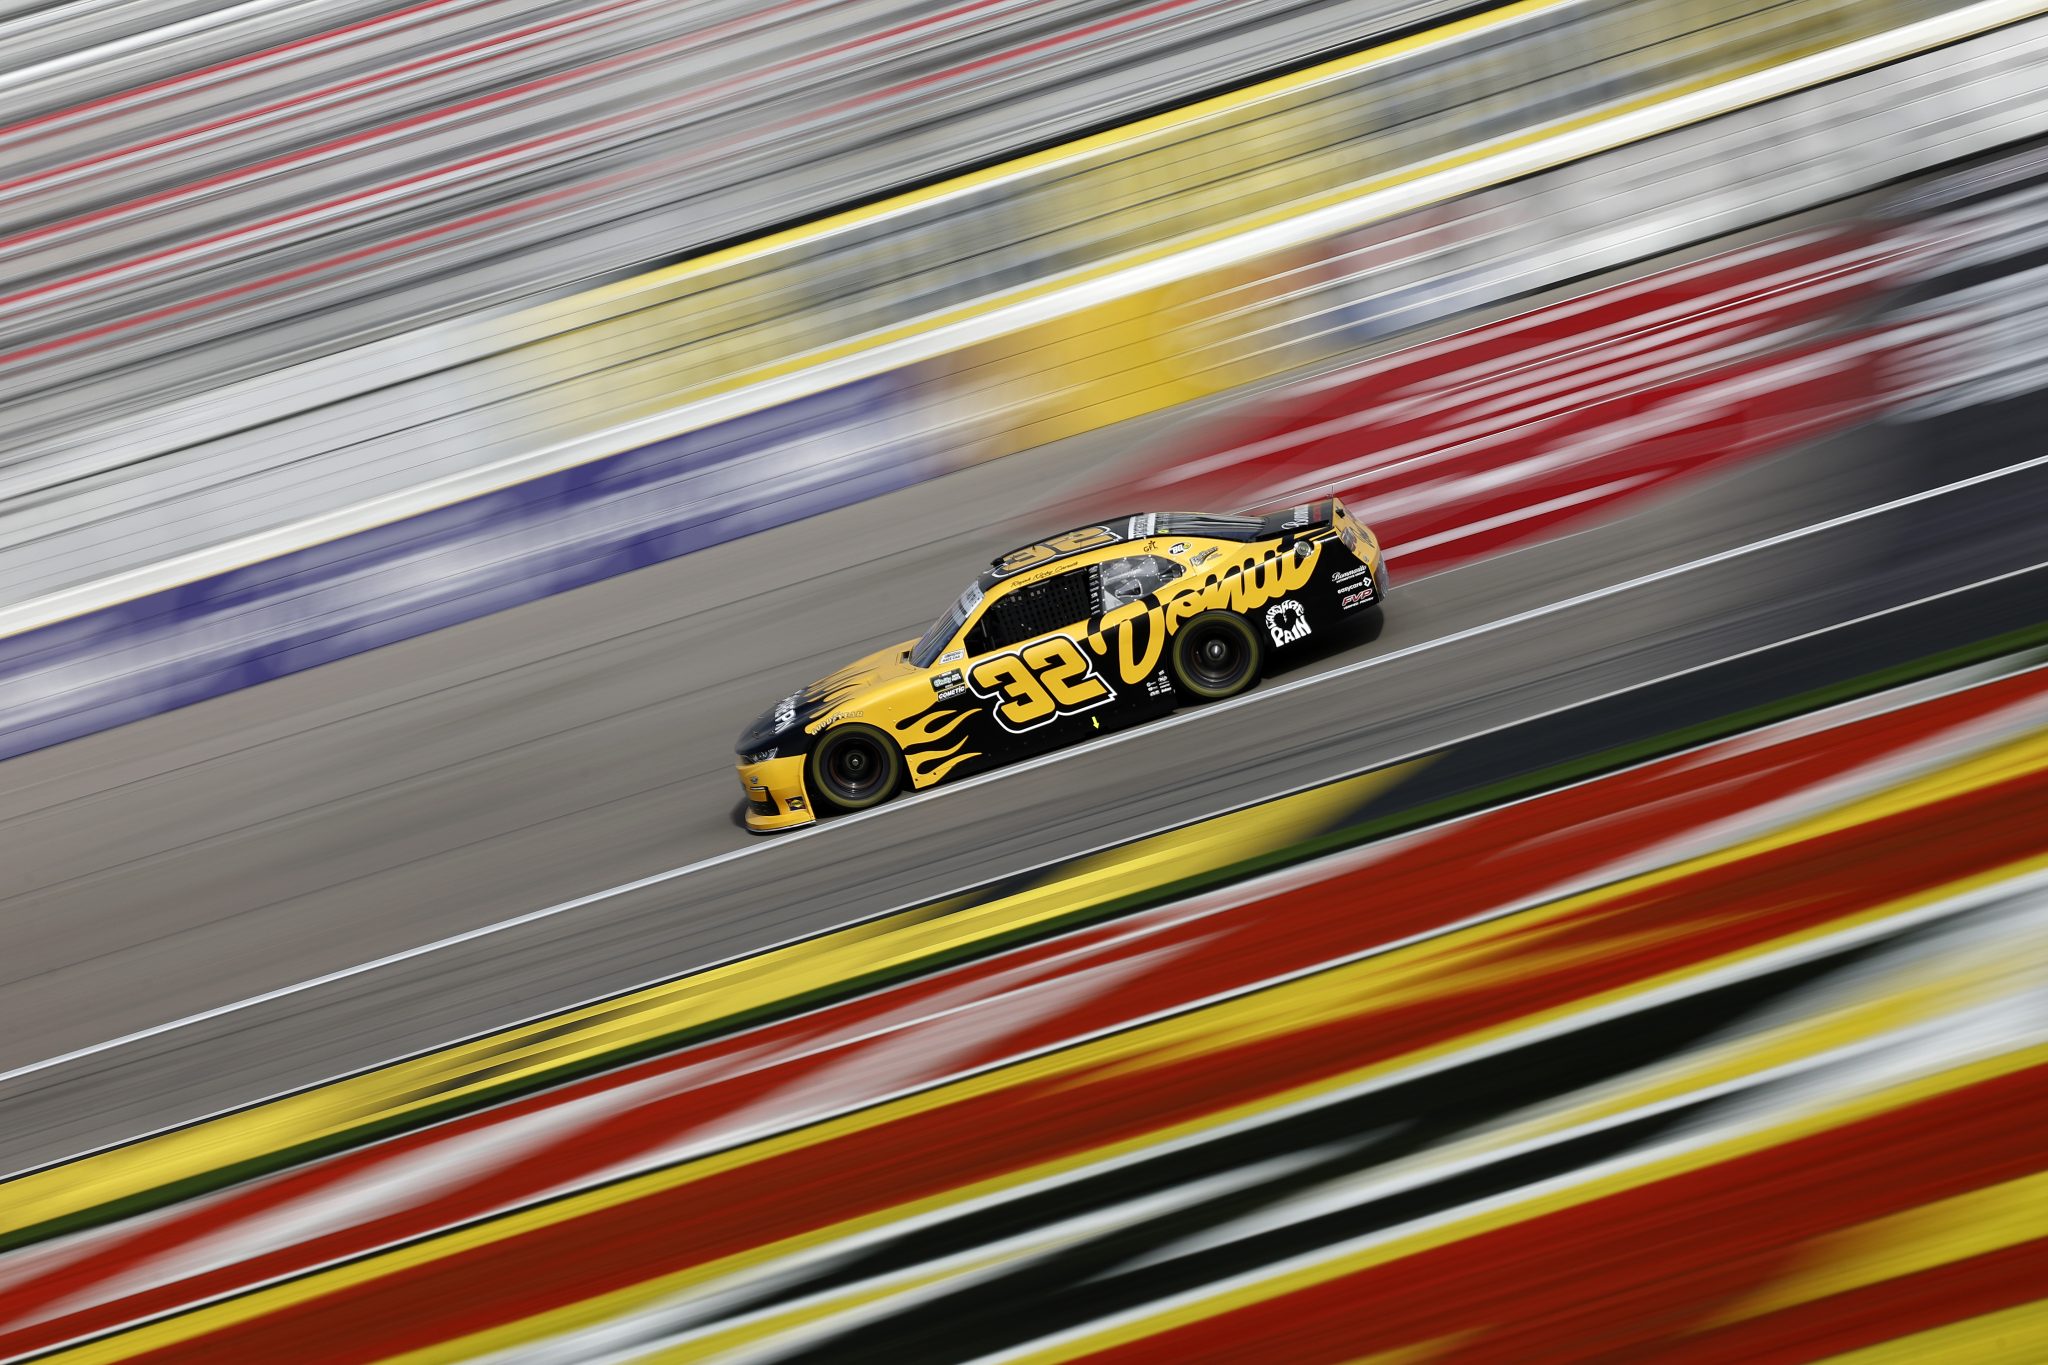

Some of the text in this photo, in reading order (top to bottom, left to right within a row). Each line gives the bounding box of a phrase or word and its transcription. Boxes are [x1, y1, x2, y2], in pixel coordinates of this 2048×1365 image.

[992, 526, 1123, 577] 32
[1337, 581, 1363, 594] easycare
[1342, 588, 1373, 606] FVP
[1087, 534, 1322, 684] Donut
[1270, 614, 1312, 647] PAIN
[938, 685, 965, 699] COMETIC
[967, 633, 1117, 733] 32
[810, 710, 864, 735] GOODYEAR
